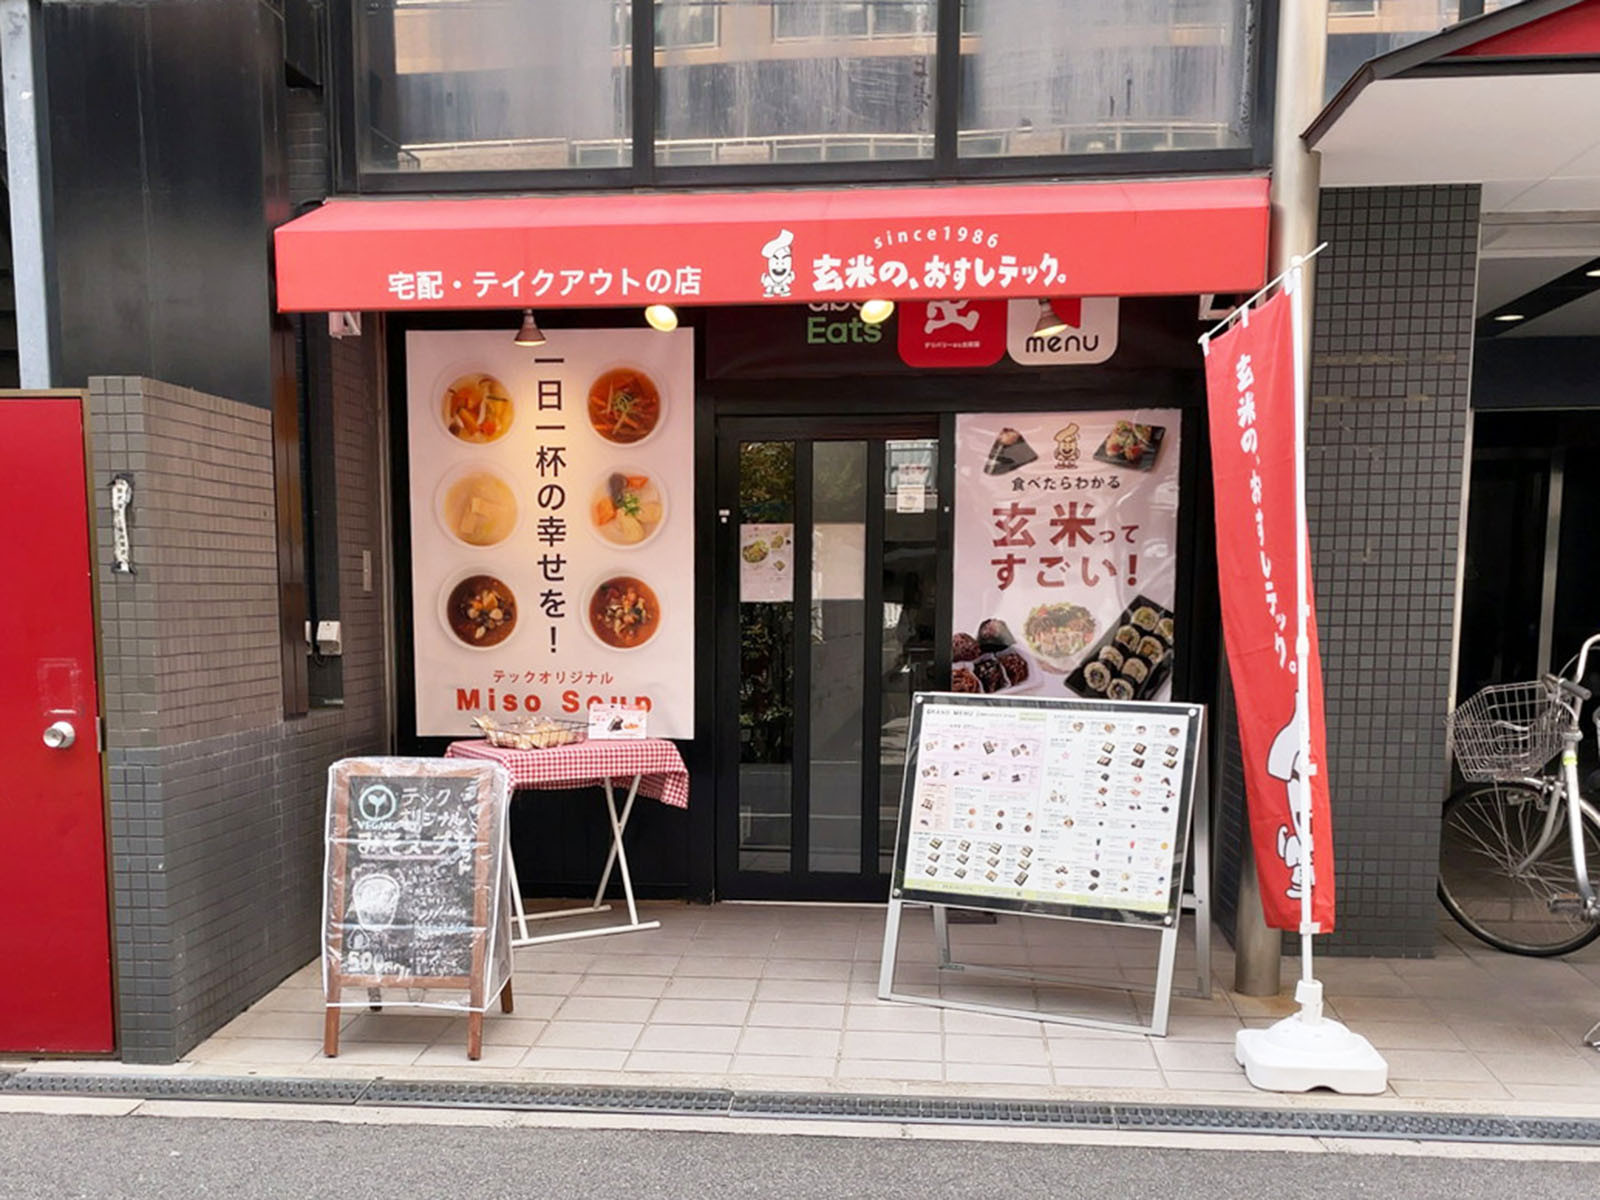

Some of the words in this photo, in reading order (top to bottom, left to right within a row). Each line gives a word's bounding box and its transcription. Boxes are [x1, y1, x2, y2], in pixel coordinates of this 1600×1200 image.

[874, 226, 1000, 250] since1986
[388, 266, 702, 301] 宅配・テイクアウトの店
[812, 252, 1067, 292] 玄米の、おすしテック。
[807, 316, 882, 344] Eats
[1026, 334, 1100, 354] menu
[1012, 475, 1121, 491] 食べたらわかる
[534, 357, 567, 653] 一日一杯の幸せを！
[993, 502, 1140, 548] 玄米って
[991, 554, 1138, 590] すごい！
[493, 670, 614, 685] テックオリジナル
[456, 688, 542, 712] Miso
